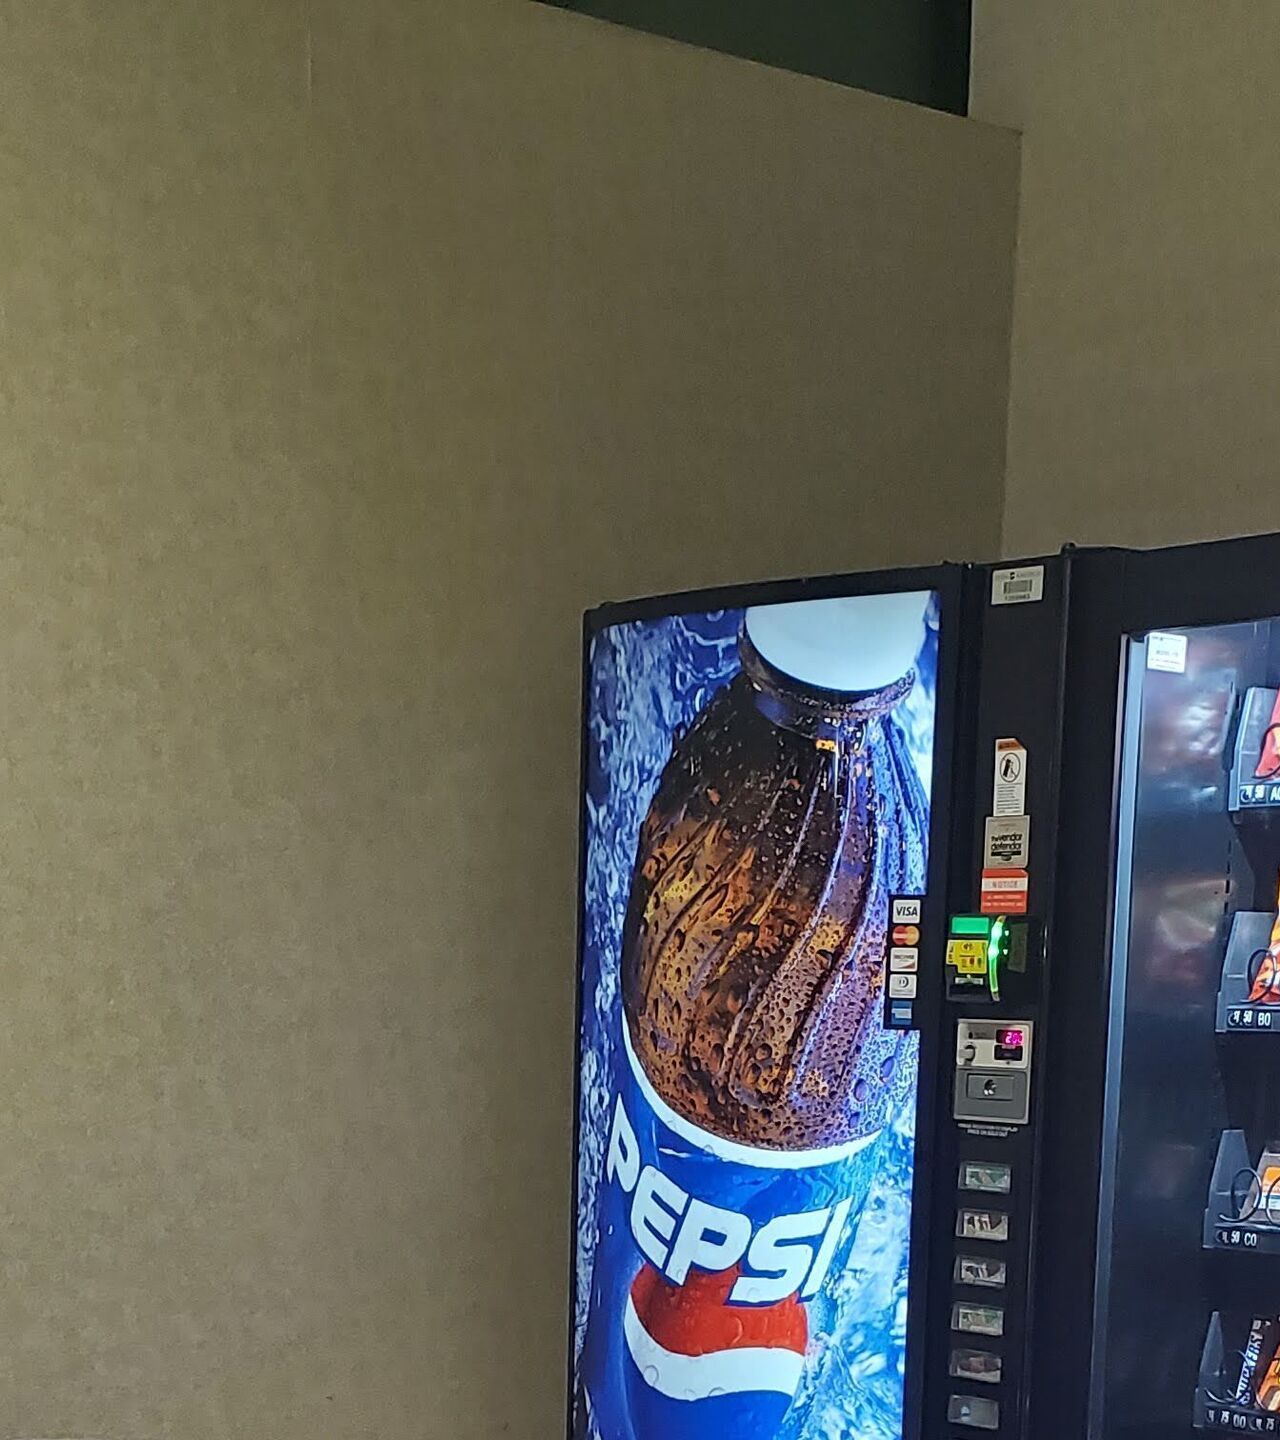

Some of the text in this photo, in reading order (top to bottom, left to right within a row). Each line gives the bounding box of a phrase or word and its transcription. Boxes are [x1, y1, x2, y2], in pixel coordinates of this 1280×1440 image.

[896, 906, 918, 917] VISA
[1258, 1013, 1271, 1027] B0
[607, 1093, 853, 1302] PEPSI
[1244, 1232, 1257, 1246] C0
